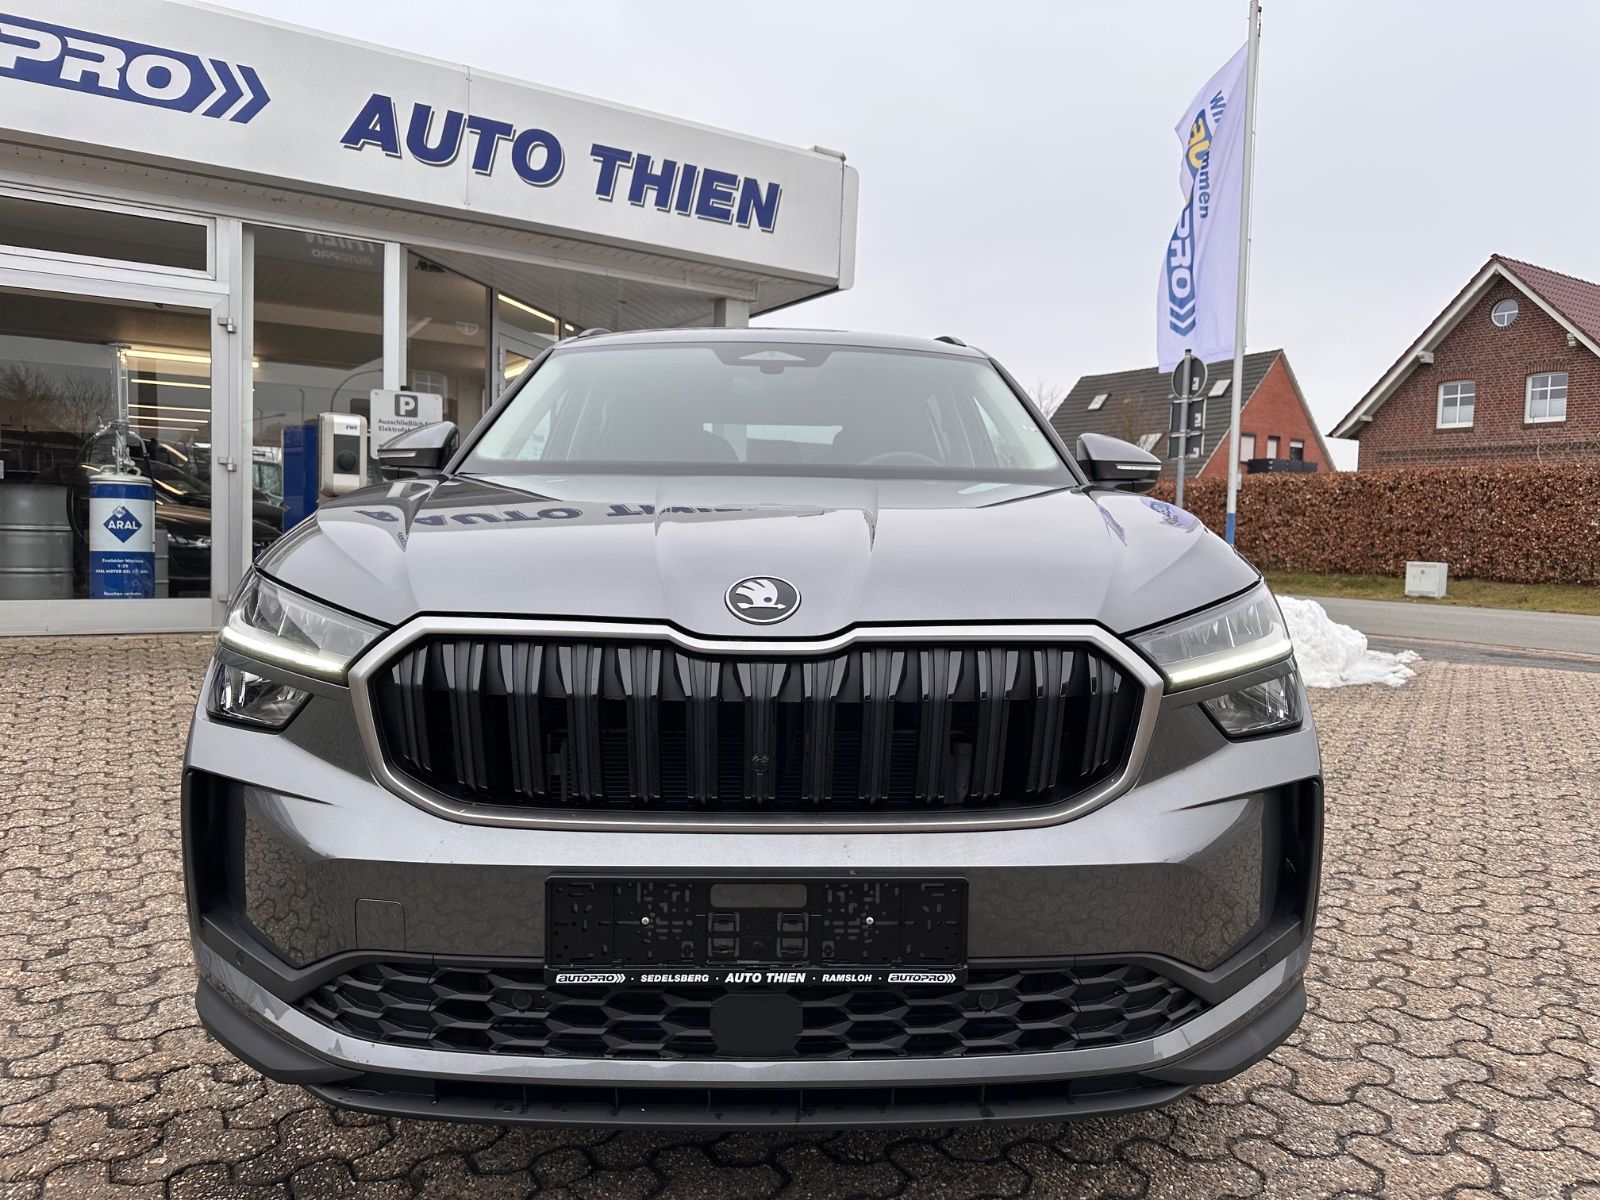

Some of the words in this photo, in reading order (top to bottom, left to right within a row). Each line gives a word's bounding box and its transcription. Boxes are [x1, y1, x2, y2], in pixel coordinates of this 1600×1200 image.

[340, 93, 564, 186] AUTO
[590, 143, 782, 233] THIEN
[399, 396, 416, 416] P
[107, 520, 139, 530] ARAL
[640, 974, 709, 983] SEDELSBERG
[725, 973, 762, 983] AUTO
[766, 973, 806, 983] THIEN
[822, 974, 872, 982] RAMSLOH
